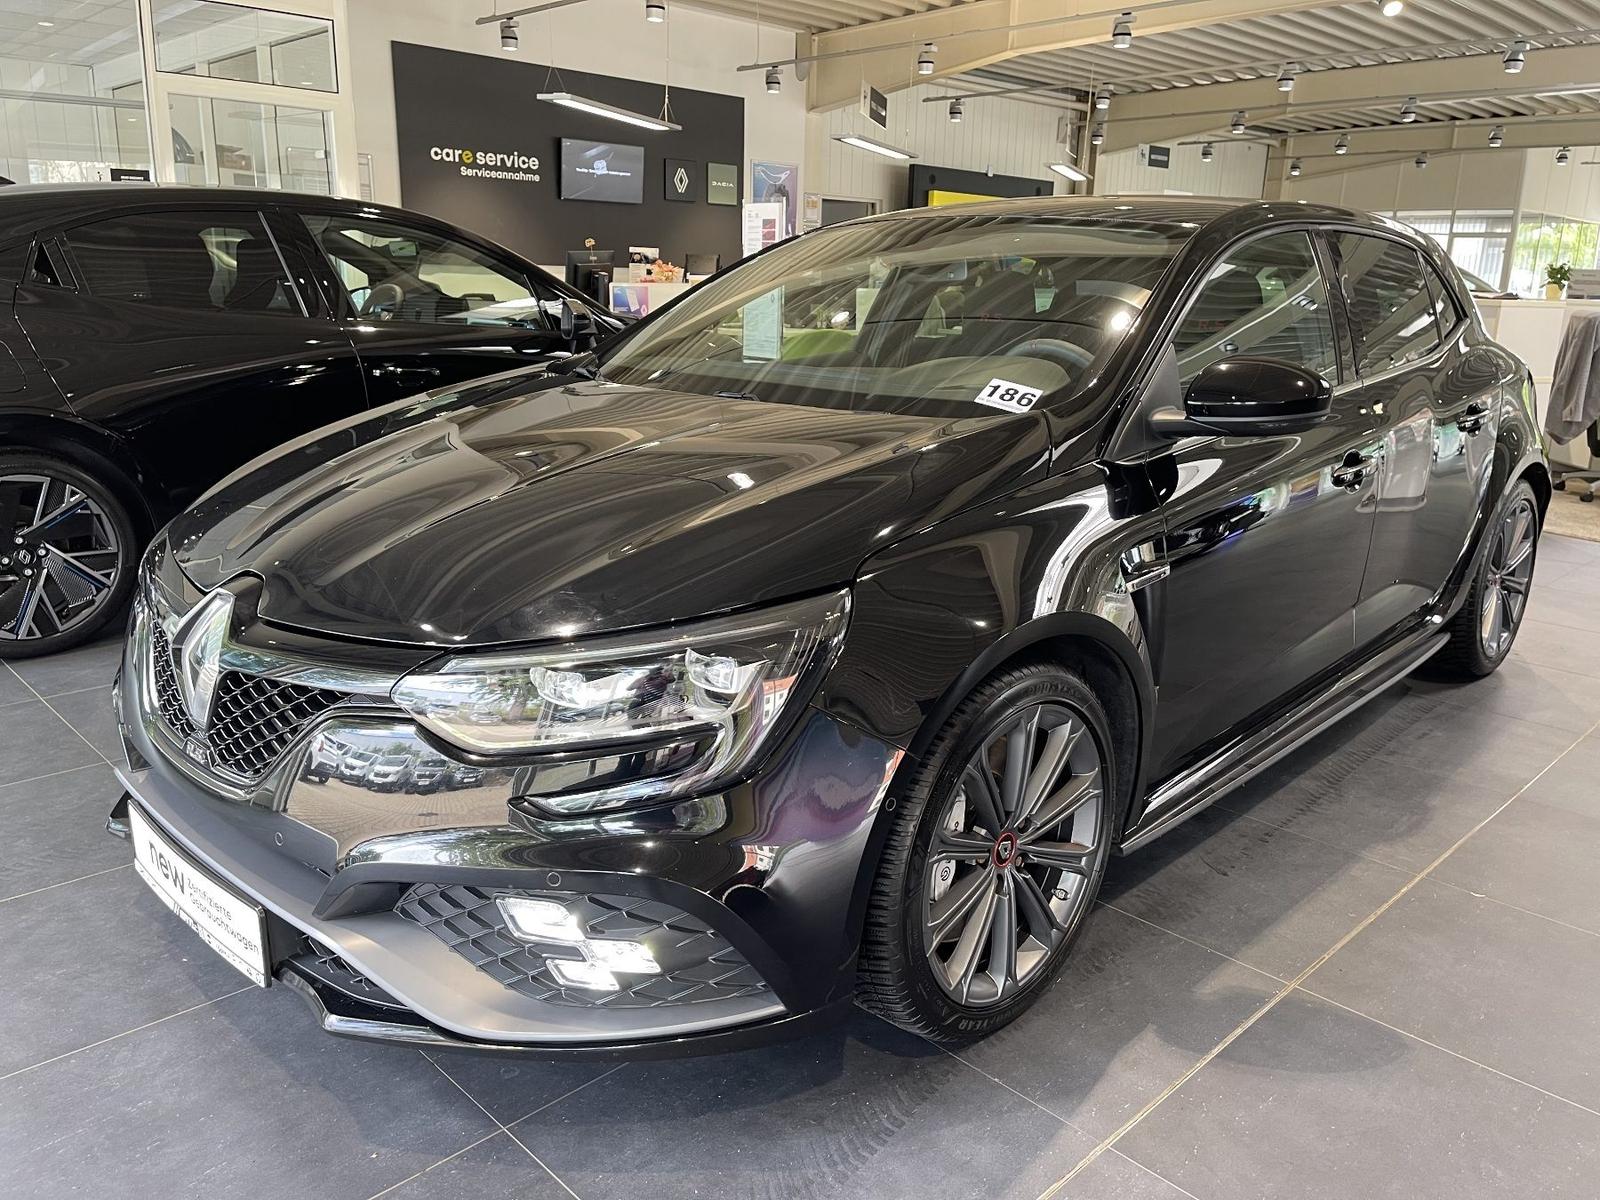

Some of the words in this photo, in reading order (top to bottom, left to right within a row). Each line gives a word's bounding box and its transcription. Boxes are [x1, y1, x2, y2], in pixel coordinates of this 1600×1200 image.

[430, 147, 474, 164] care
[476, 151, 540, 170] service
[460, 165, 540, 182] Serviceannahme
[986, 384, 1037, 407] 186
[148, 840, 185, 896] new
[189, 891, 260, 956] Gebrauchtwagen
